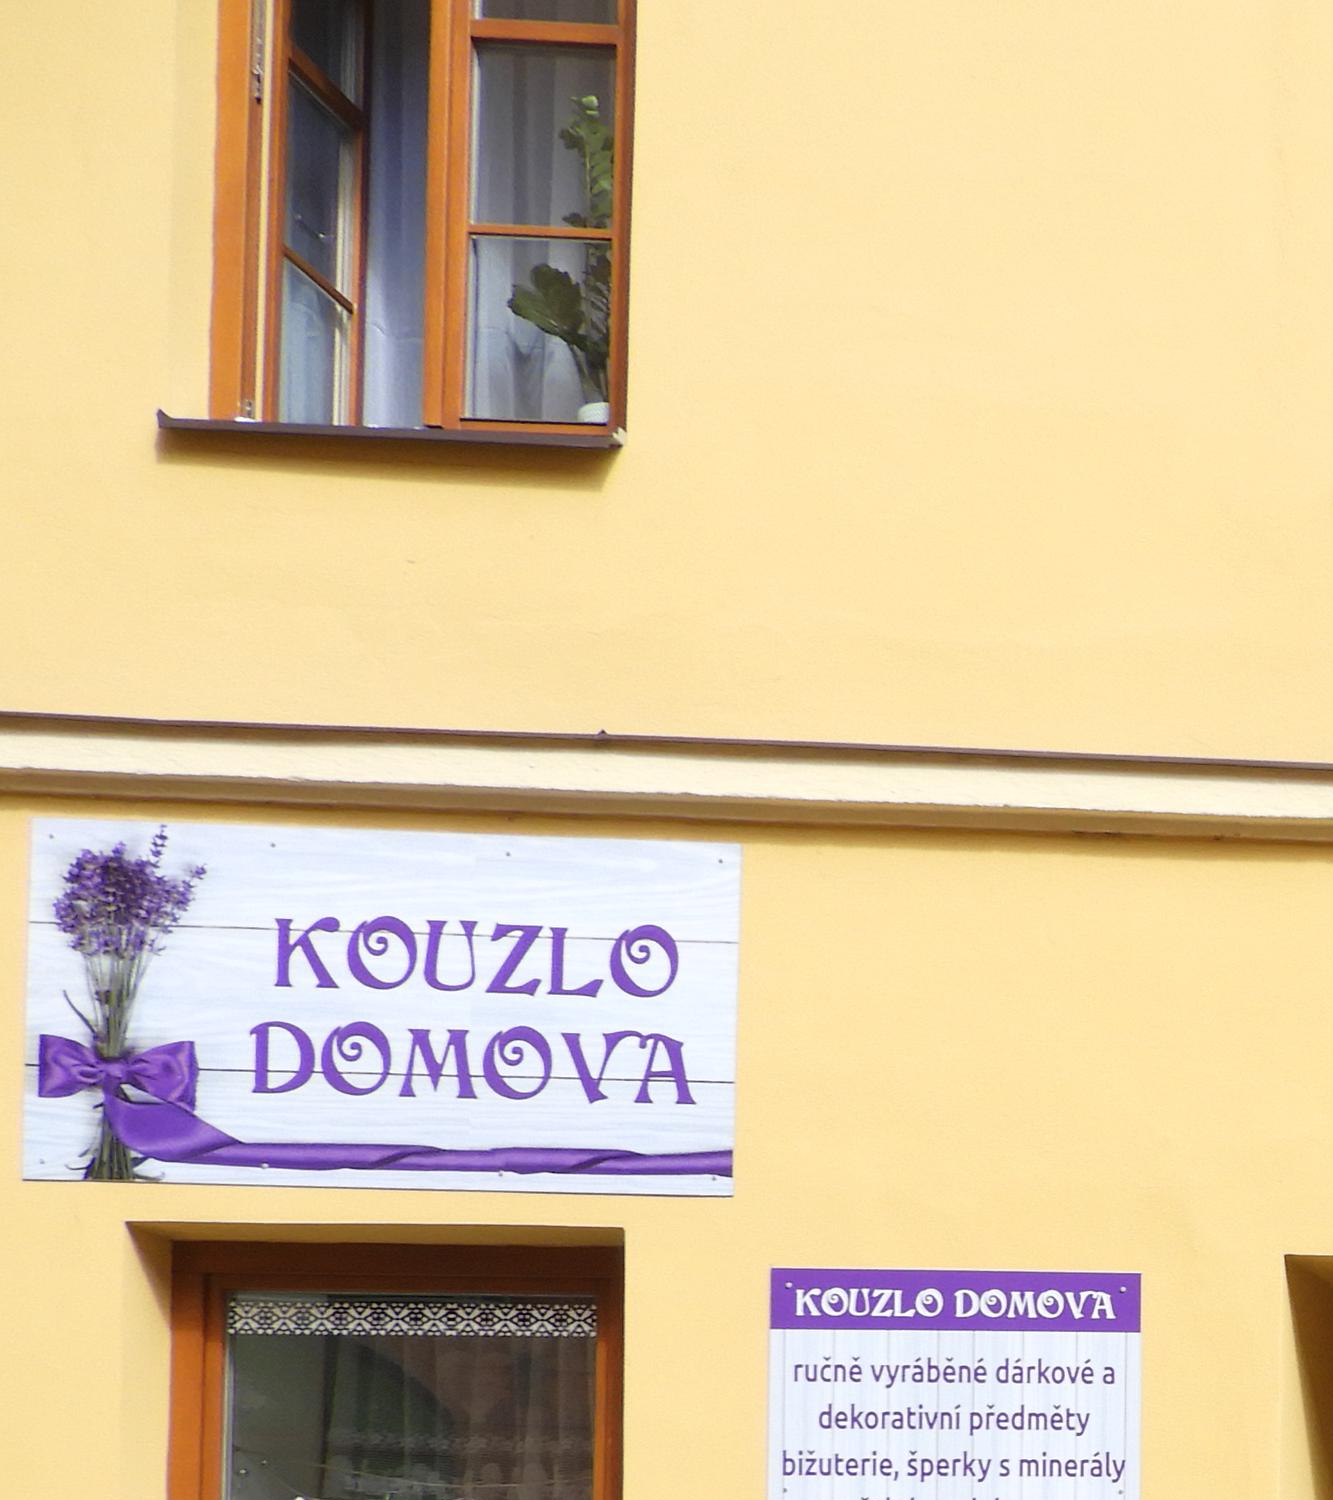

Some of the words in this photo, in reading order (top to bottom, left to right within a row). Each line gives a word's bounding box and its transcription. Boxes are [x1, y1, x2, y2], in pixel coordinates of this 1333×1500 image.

[274, 915, 679, 998] KOUZLO
[249, 1020, 696, 1105] DOMOVA
[794, 1286, 943, 1319] KOUZLO
[954, 1288, 1116, 1320] DOMOVA
[794, 1357, 863, 1383] ručně
[871, 1357, 987, 1388] vyráběné
[995, 1358, 1094, 1384] dárkové
[1102, 1366, 1115, 1385] a
[818, 1404, 962, 1429] dekorativní
[969, 1405, 1090, 1436] předměty
[782, 1450, 899, 1481] bižuterie,
[907, 1451, 992, 1482] šperky
[999, 1459, 1010, 1477] s
[1019, 1451, 1126, 1482] minerály
